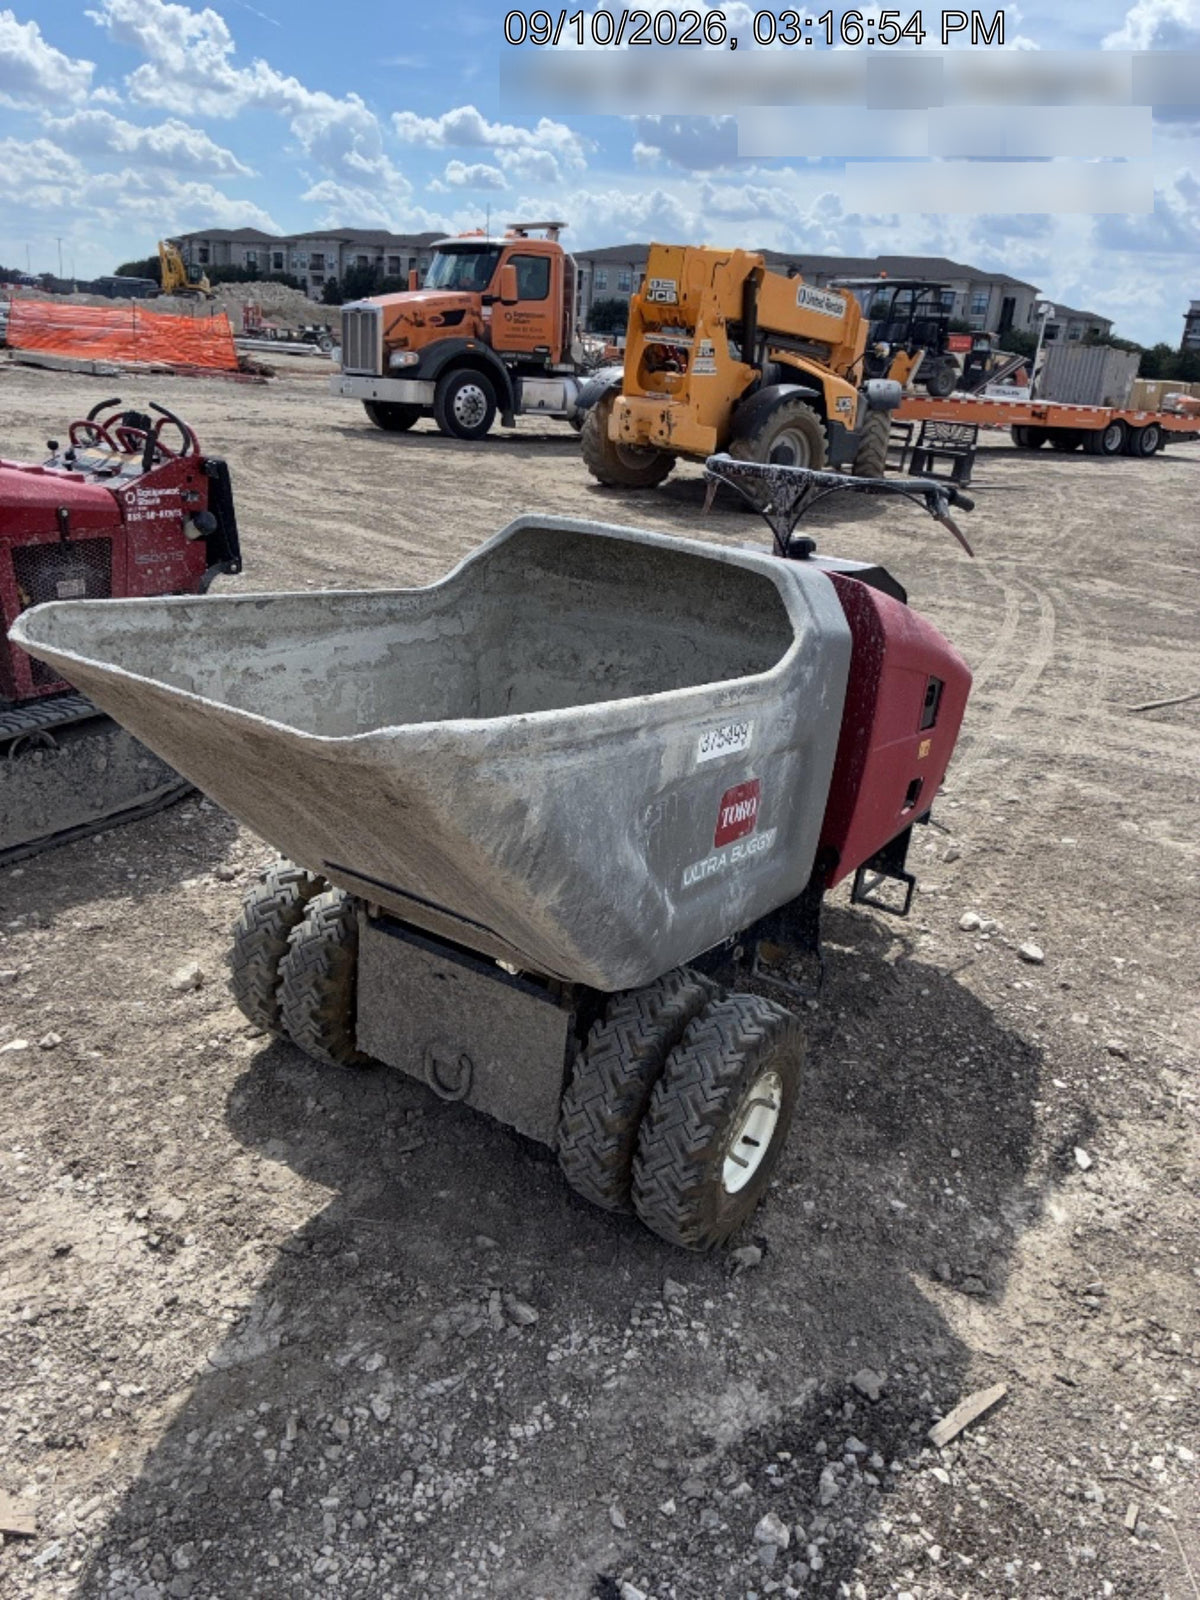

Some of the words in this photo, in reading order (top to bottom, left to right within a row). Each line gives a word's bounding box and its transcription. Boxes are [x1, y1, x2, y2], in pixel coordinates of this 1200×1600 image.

[721, 797, 757, 829] TORO
[683, 852, 727, 886] ULTRA
[730, 831, 775, 863] BUGGY
